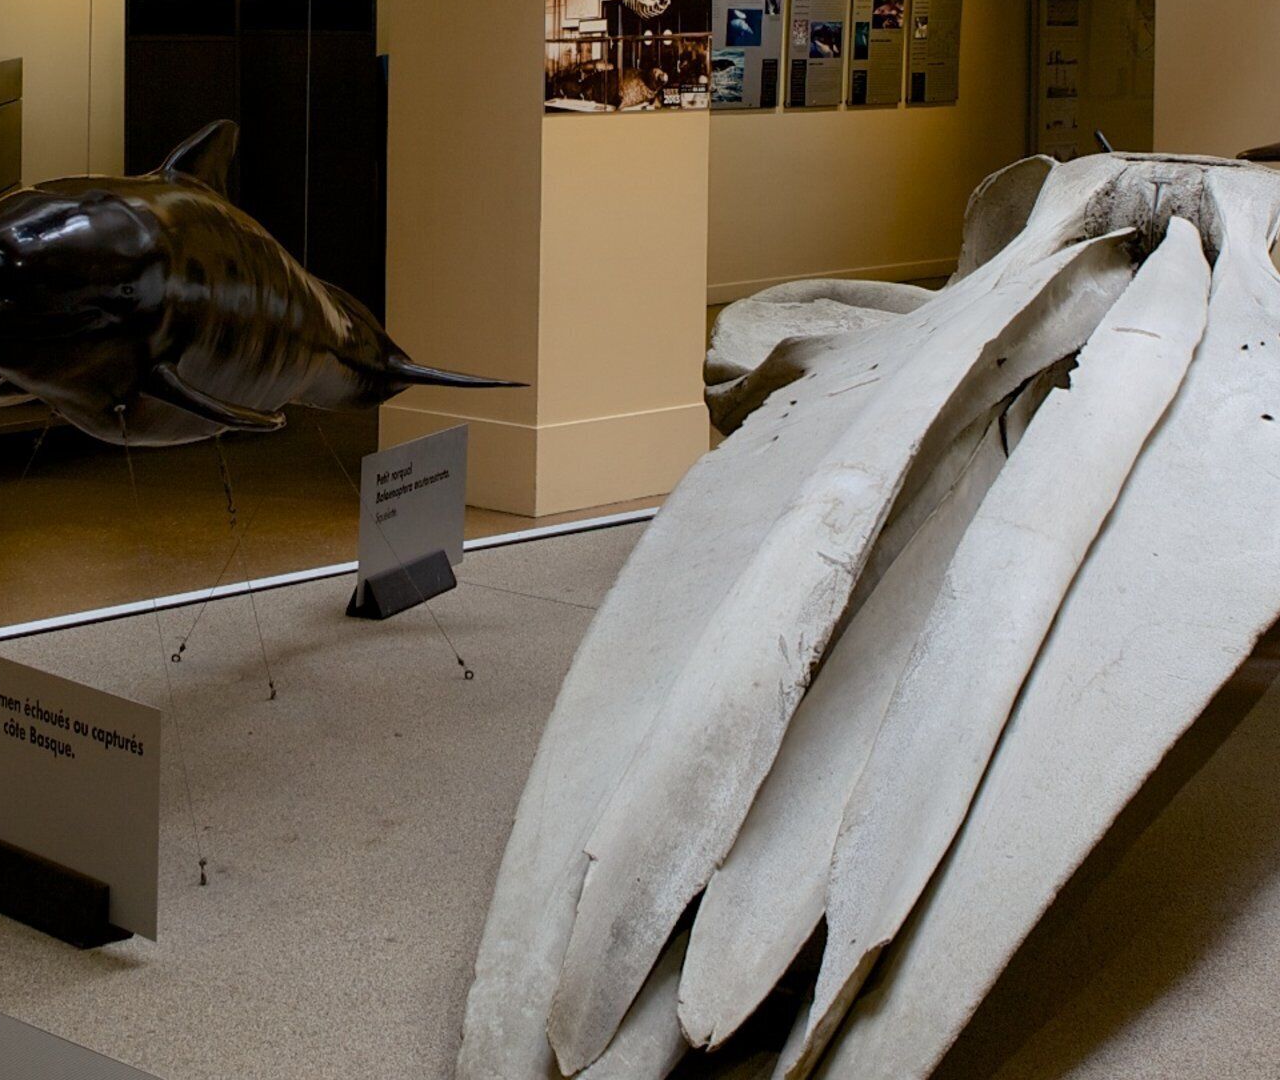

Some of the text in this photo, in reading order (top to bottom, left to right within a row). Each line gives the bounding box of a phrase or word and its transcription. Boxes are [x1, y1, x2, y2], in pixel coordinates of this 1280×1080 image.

[3, 717, 26, 740] côte
[29, 726, 76, 760] Basque.
[23, 697, 71, 730] échoués
[73, 720, 89, 737] ou
[91, 726, 144, 757] capturés
